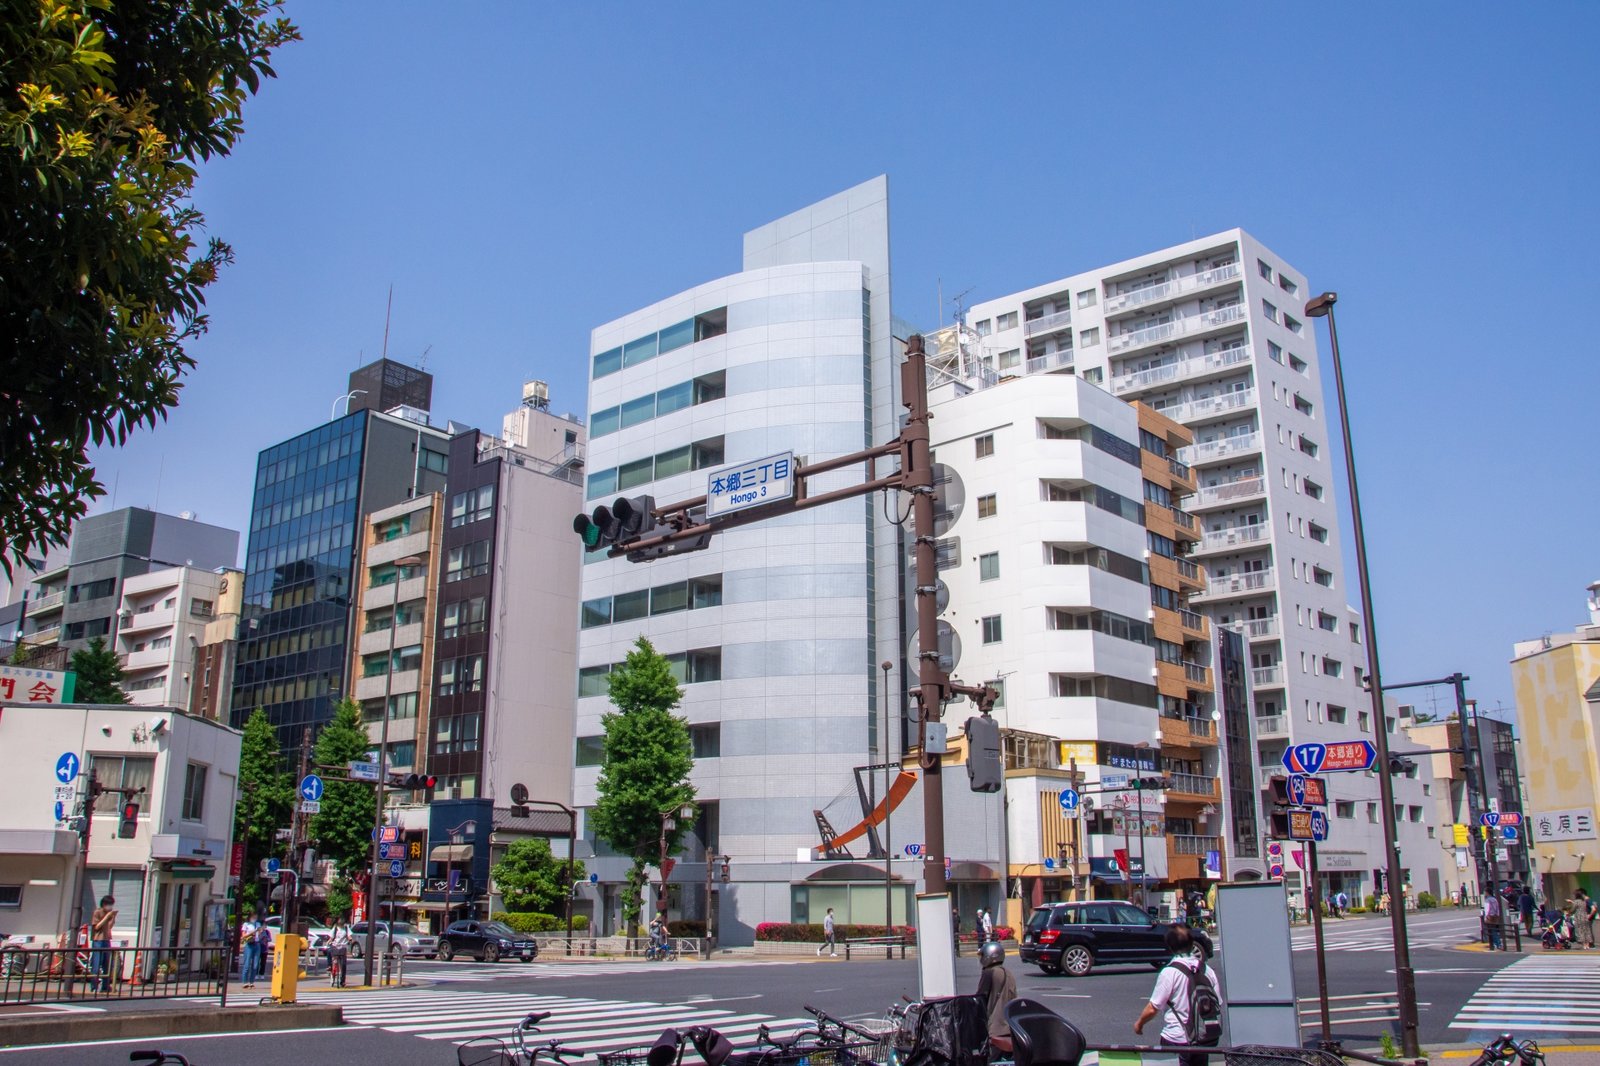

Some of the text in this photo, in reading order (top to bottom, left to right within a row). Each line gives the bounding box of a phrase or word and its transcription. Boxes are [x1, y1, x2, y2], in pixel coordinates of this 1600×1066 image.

[711, 460, 788, 496] 本郷三丁目
[731, 486, 767, 504] Hongo 3
[1300, 746, 1320, 766] 17
[1327, 744, 1363, 759] 本郷通り
[354, 764, 380, 773] 本郷三丁
[1293, 778, 1304, 793] 254
[1312, 818, 1323, 834] 453
[1489, 815, 1498, 823] 17
